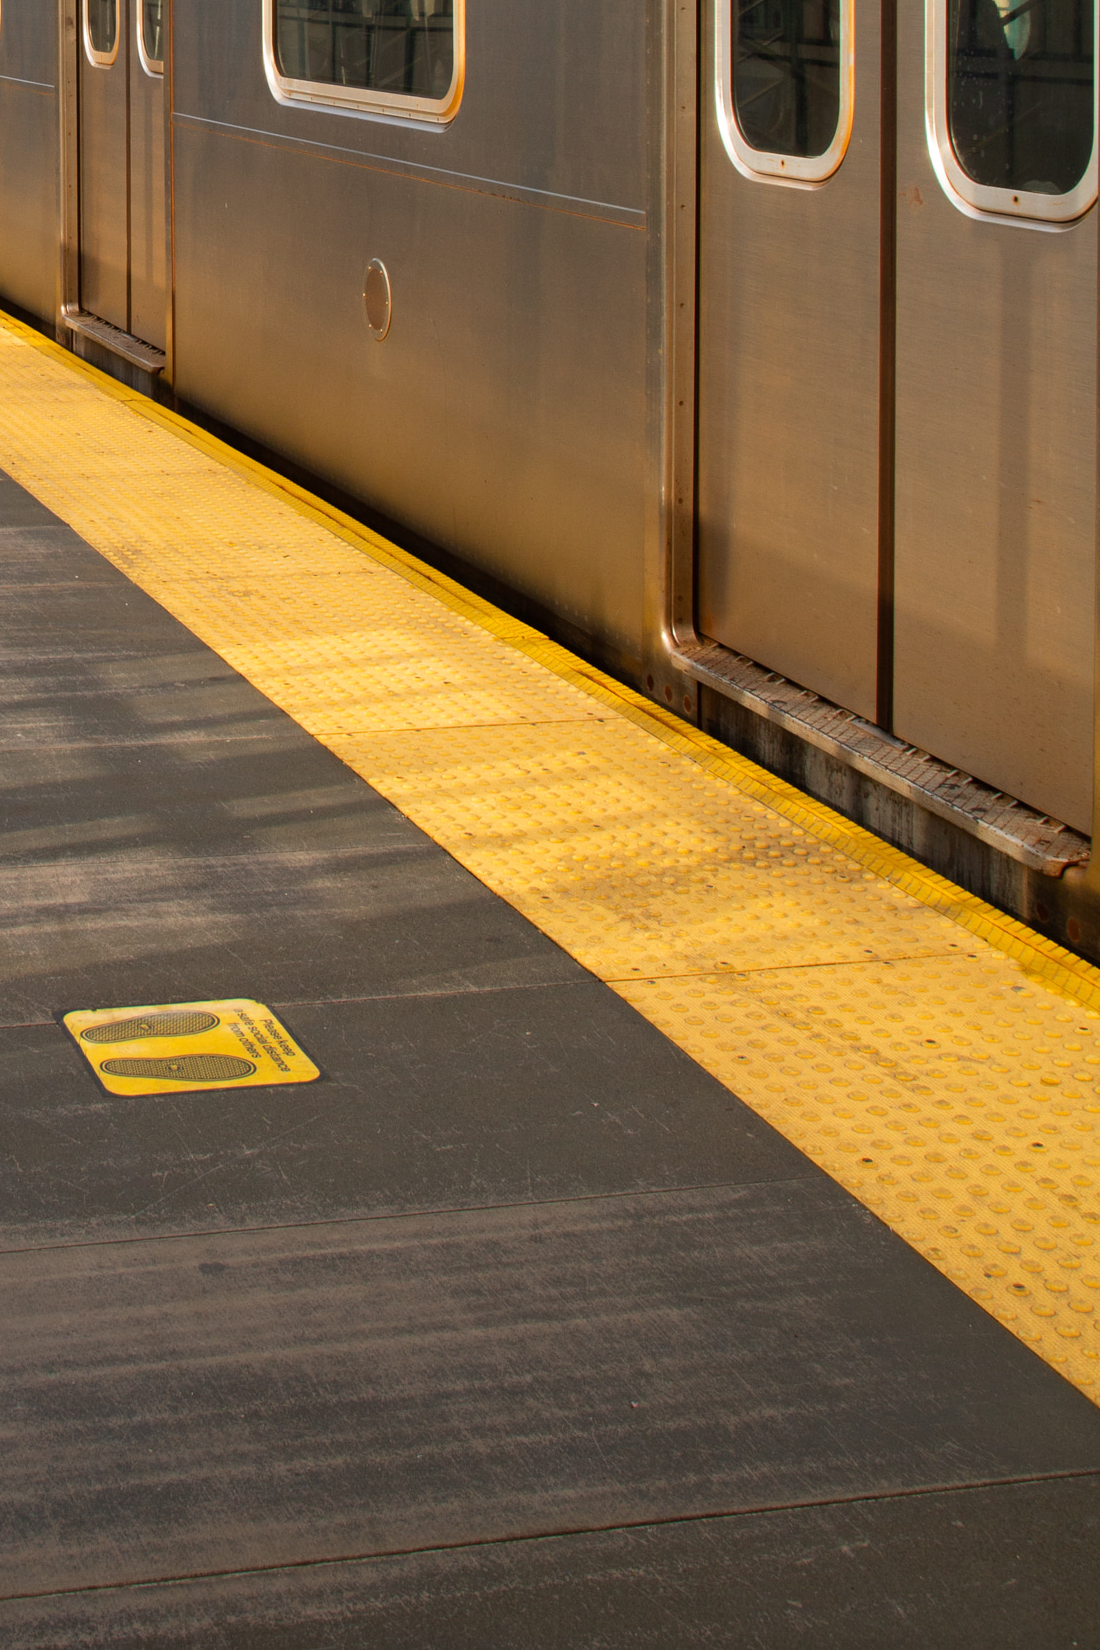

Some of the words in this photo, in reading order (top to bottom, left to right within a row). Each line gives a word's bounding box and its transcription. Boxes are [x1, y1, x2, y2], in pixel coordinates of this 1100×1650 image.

[227, 1022, 245, 1037] from
[239, 1038, 262, 1058] others
[237, 1013, 255, 1025] safe
[248, 1026, 273, 1044] social
[262, 1045, 291, 1072] distance
[260, 1019, 282, 1039] Please
[276, 1040, 296, 1056] keep
